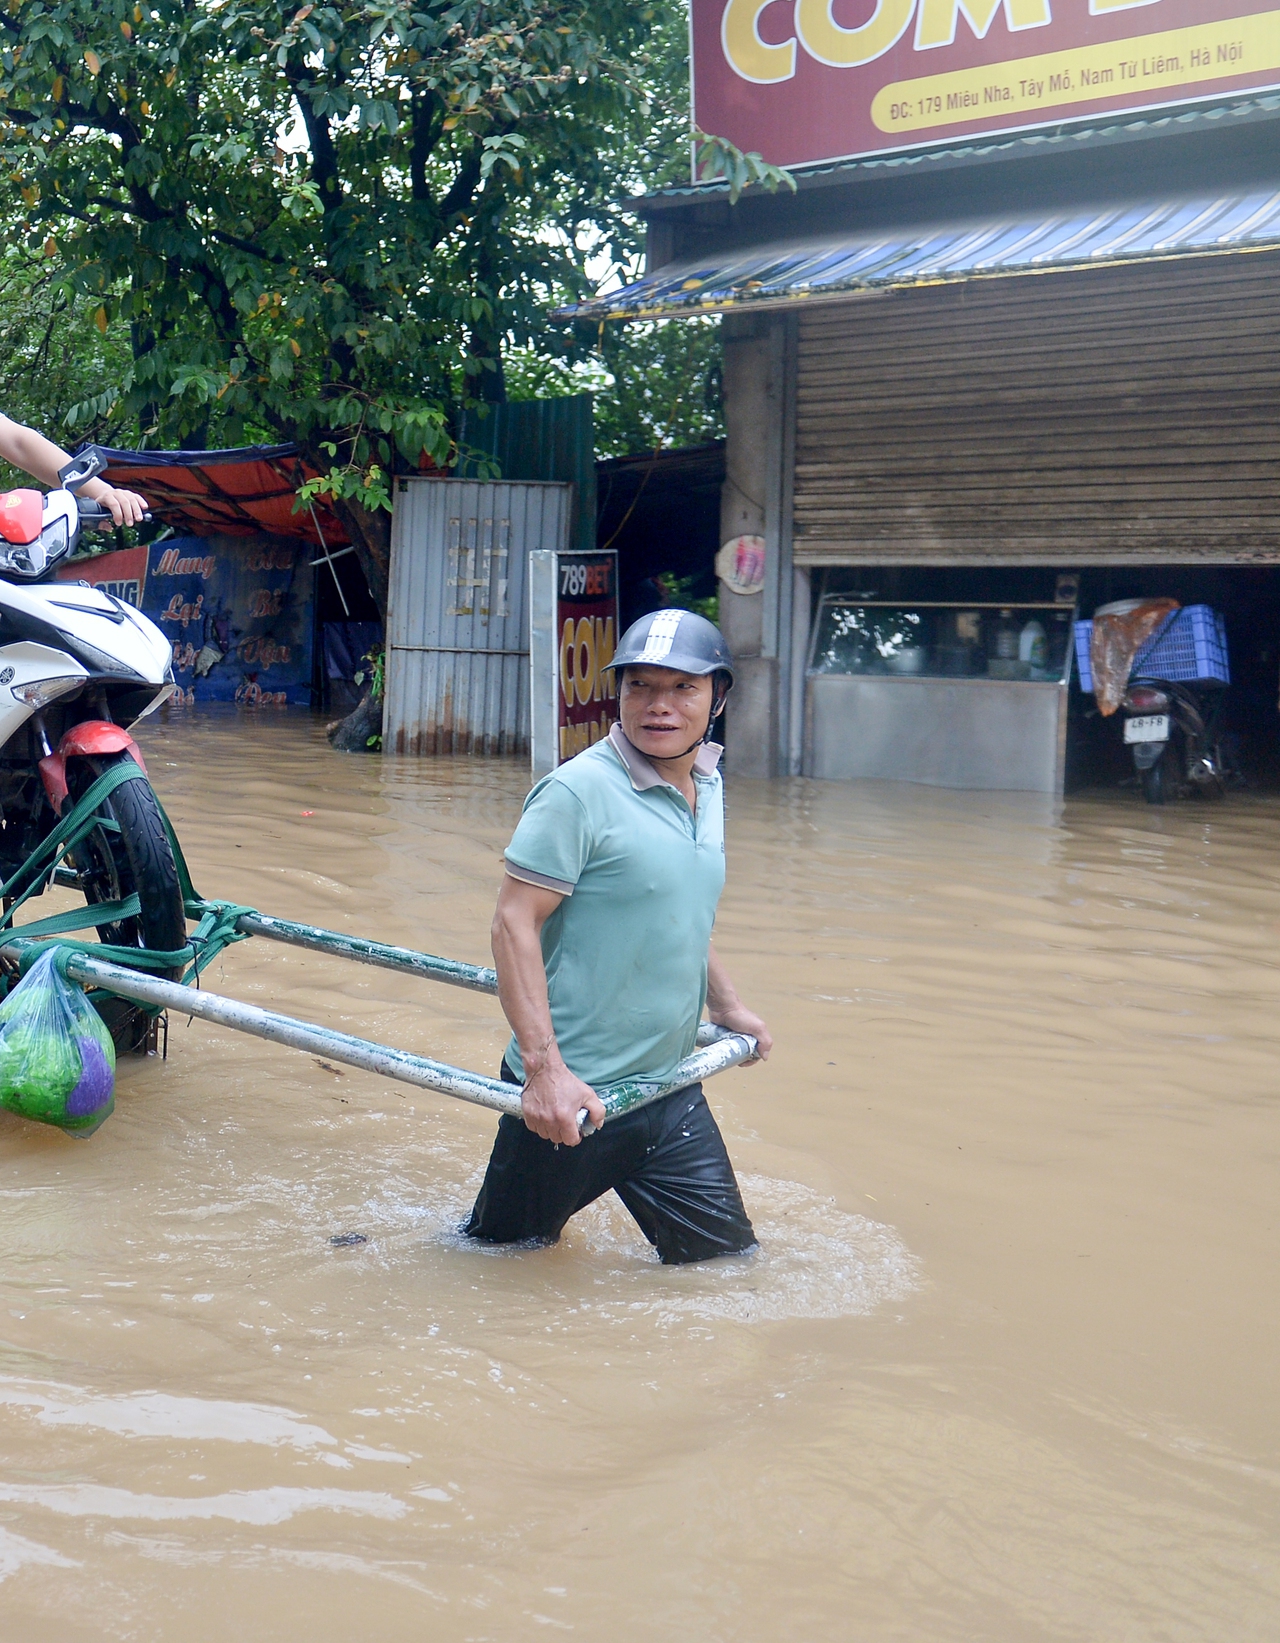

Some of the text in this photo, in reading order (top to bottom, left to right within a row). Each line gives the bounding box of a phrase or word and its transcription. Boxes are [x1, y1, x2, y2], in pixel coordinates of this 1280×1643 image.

[890, 101, 913, 120] ĐC:
[918, 96, 942, 115] 179
[984, 85, 1014, 104] Nha,
[1019, 79, 1044, 98] Tây
[1080, 67, 1113, 87] Nam
[1119, 60, 1138, 79] Từ
[1143, 55, 1185, 76] Liêm,
[1190, 47, 1210, 68] Hà
[1217, 41, 1243, 65] Nội
[152, 548, 216, 579] Mang
[560, 562, 608, 595] 789BET
[590, 710, 617, 745] DÂ
